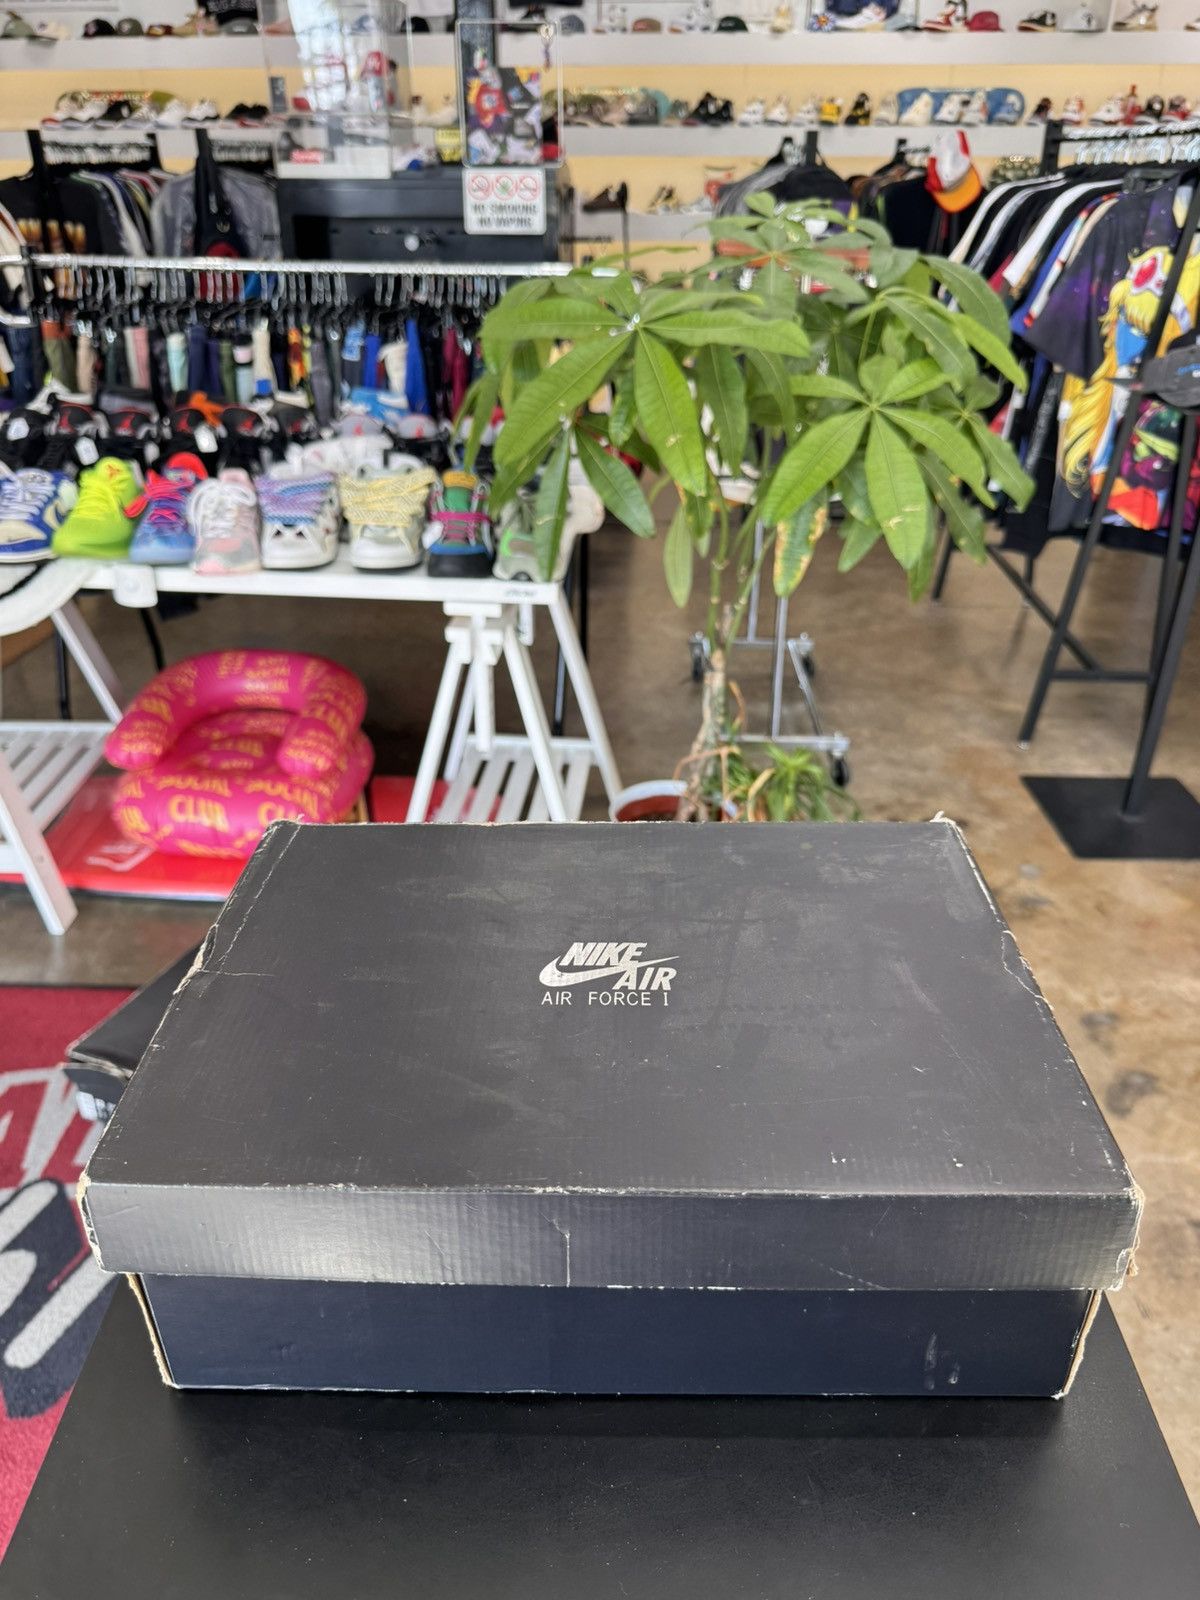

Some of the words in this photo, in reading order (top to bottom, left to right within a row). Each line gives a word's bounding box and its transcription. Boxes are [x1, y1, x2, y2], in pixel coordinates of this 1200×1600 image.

[559, 942, 648, 966] NIKE
[611, 964, 677, 990] AIR
[541, 991, 572, 1006] AIR
[588, 991, 652, 1006] FORCE
